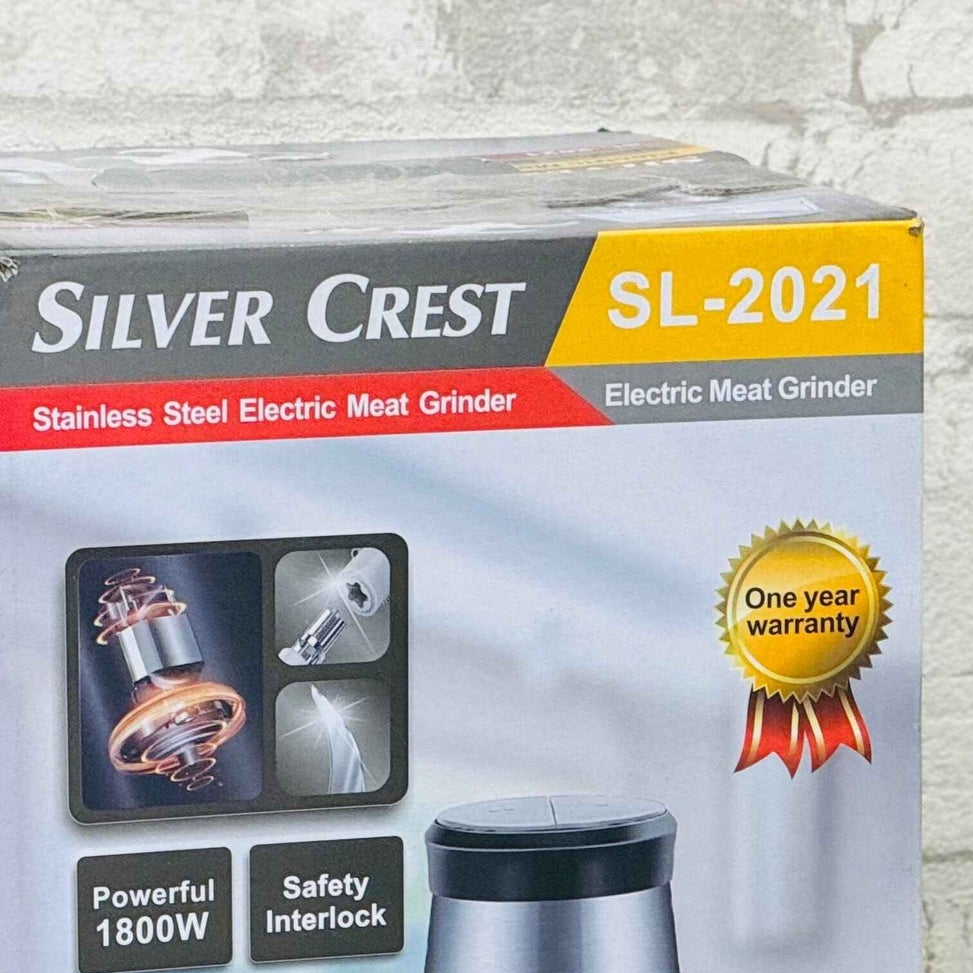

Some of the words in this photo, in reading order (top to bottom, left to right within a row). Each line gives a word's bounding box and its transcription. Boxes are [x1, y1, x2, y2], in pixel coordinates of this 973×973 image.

[607, 263, 880, 329] SL-2021
[32, 281, 274, 353] SILVER
[306, 273, 527, 343] CREST
[605, 380, 703, 407] Electric
[709, 377, 773, 402] Meat
[778, 374, 878, 400] Grinder
[33, 403, 153, 431] Stainless
[163, 398, 229, 426] Steel
[240, 395, 336, 423] Electric
[347, 392, 409, 418] Meat
[419, 388, 517, 414] Grinder
[745, 587, 797, 610] One
[804, 588, 861, 613] year
[747, 612, 860, 638] warranty
[92, 878, 216, 910] Powerful
[282, 873, 370, 901] Safety
[96, 911, 209, 947] 1800W
[266, 903, 387, 934] Interlock
